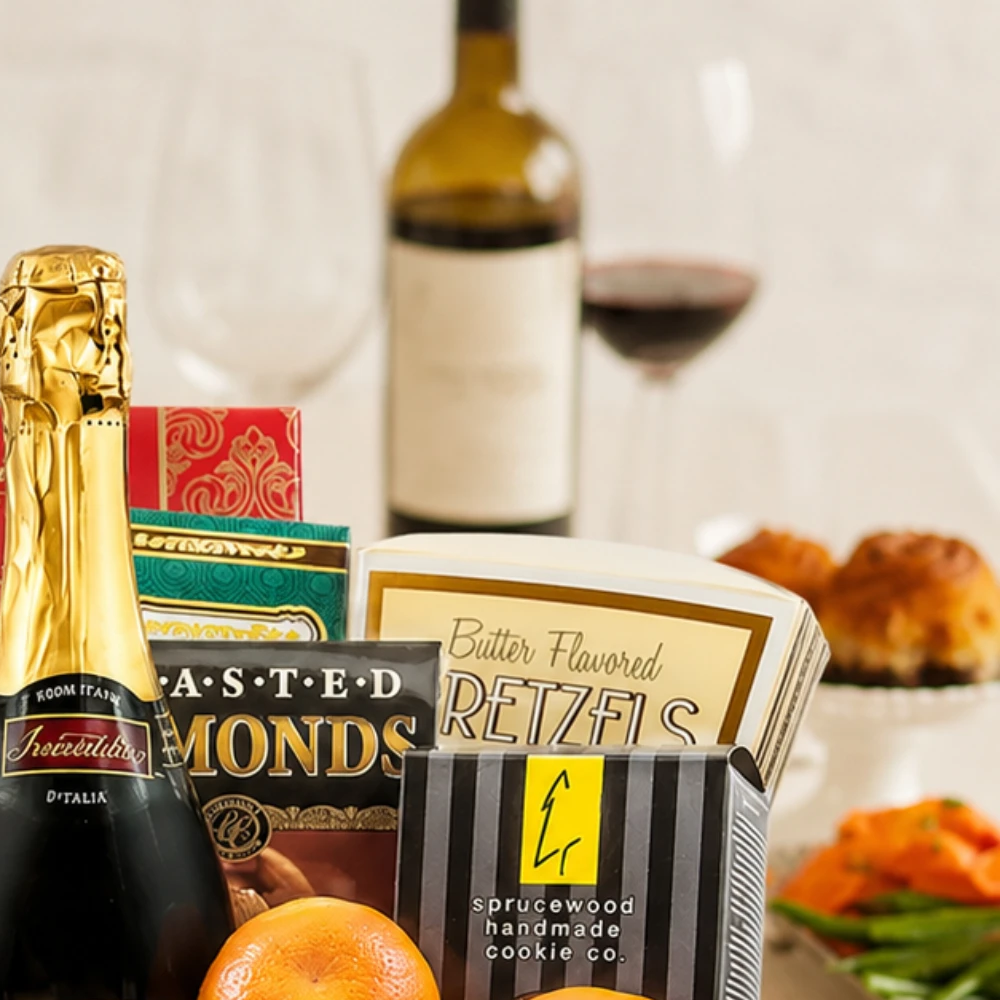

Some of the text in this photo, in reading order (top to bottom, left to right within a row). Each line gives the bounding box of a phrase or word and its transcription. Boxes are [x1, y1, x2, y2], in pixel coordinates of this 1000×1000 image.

[448, 617, 663, 682] Butter Flavored
[472, 897, 634, 916] sprucewood
[485, 919, 620, 938] handmade
[485, 942, 626, 962] cookie co.
